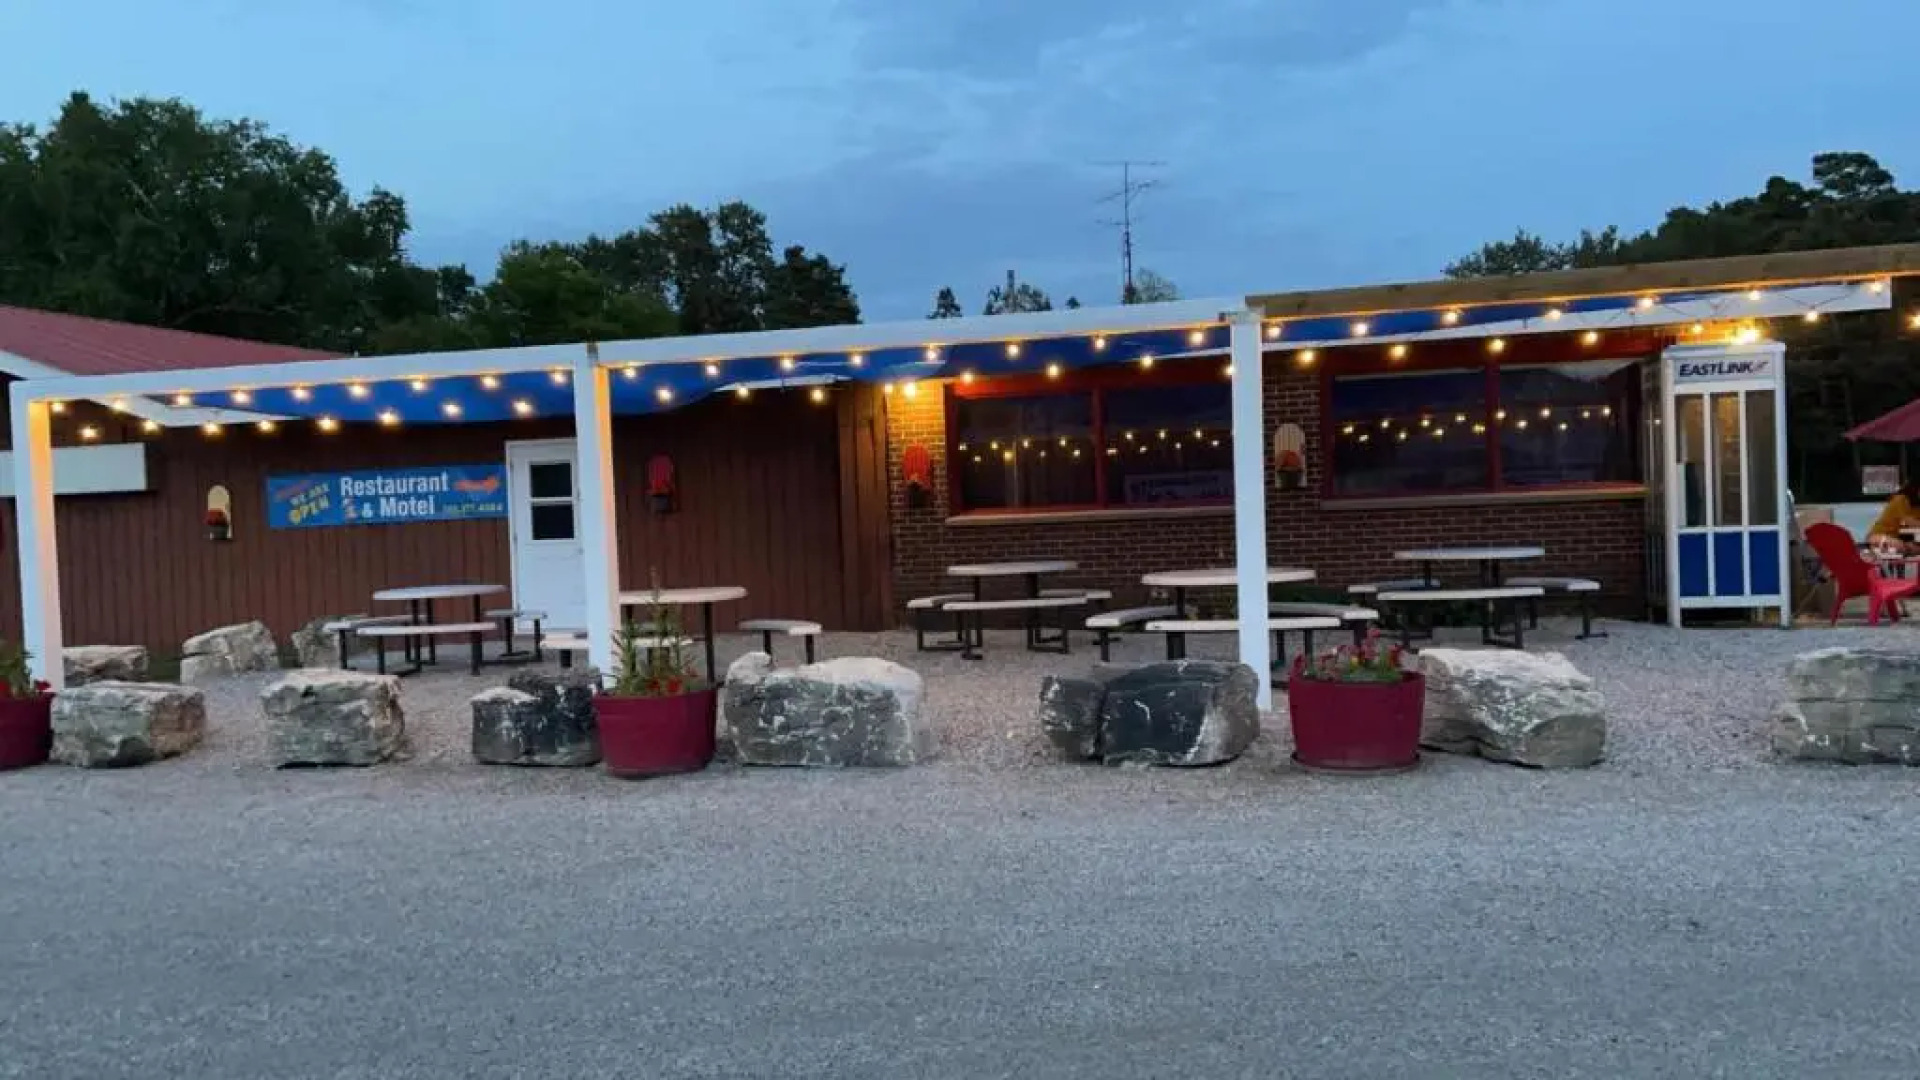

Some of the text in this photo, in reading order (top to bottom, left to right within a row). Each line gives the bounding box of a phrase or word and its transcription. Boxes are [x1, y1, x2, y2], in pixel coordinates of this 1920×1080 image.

[1679, 361, 1753, 377] EASTLINK
[340, 471, 449, 496] Restaurant
[289, 494, 329, 524] OPEN
[361, 502, 374, 518] &
[380, 494, 435, 517] Motel
